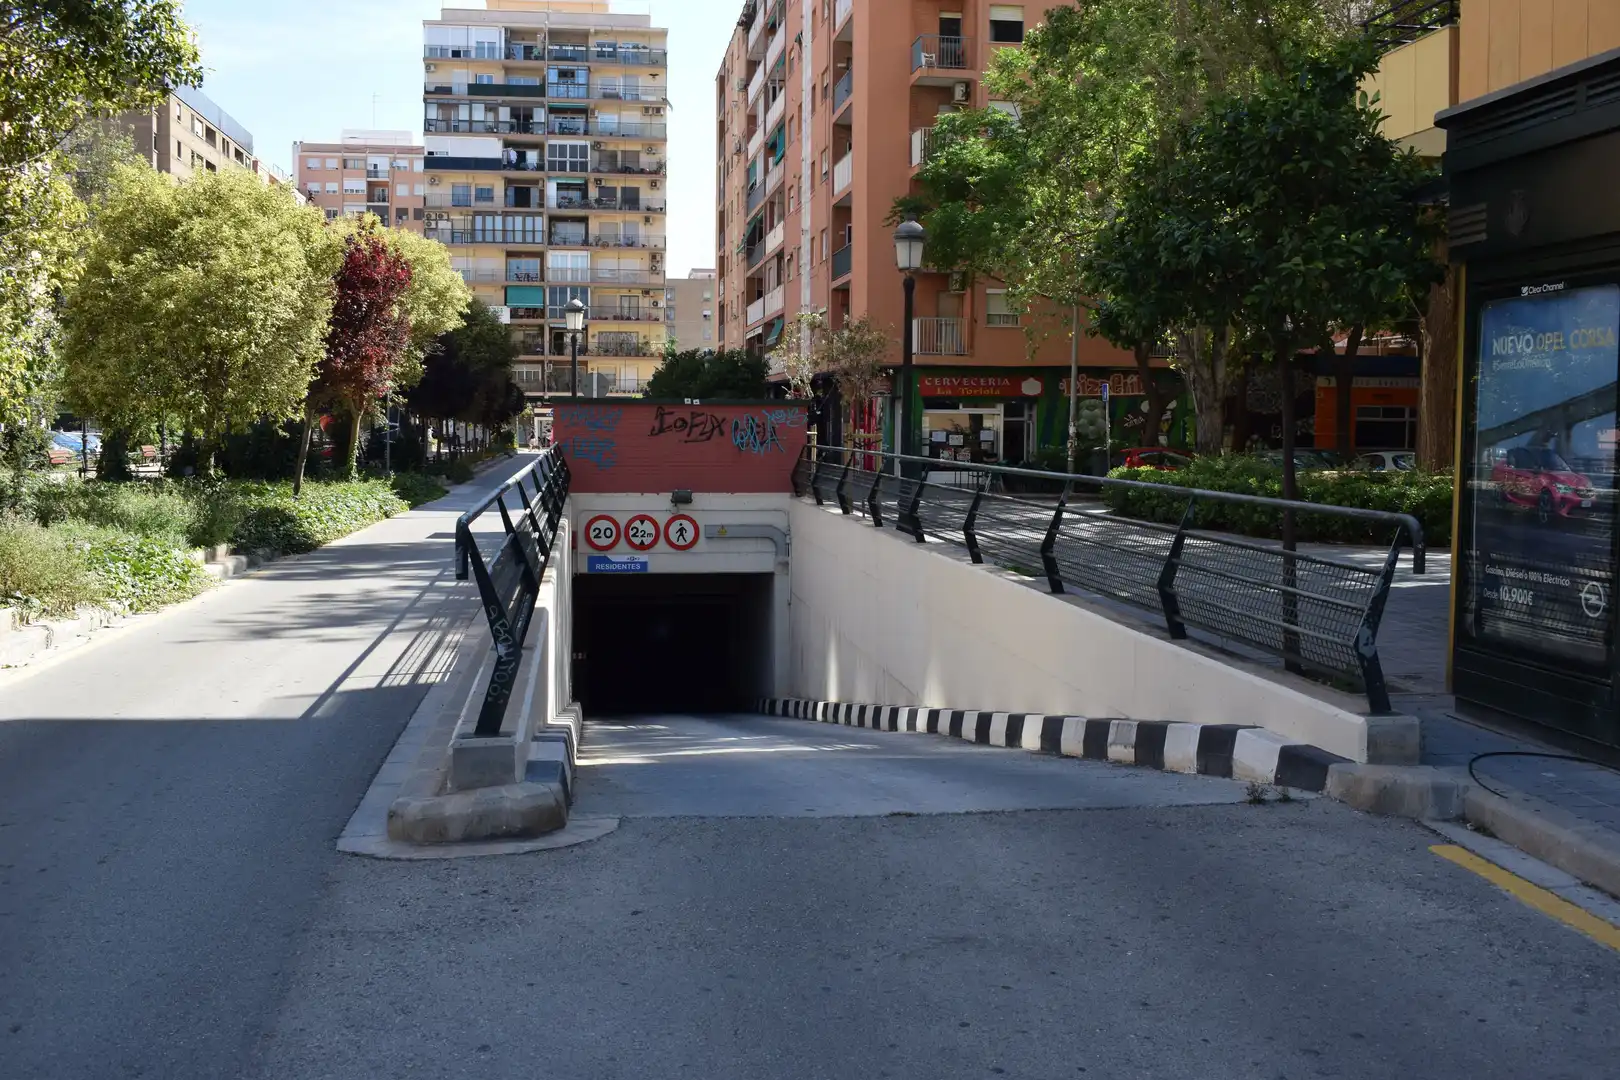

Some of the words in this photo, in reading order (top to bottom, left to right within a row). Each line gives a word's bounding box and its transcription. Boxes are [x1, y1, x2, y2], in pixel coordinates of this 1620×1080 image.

[1529, 285, 1541, 294] Clear
[1542, 281, 1564, 292] Channel
[1492, 334, 1534, 355] NUEVO
[1536, 331, 1566, 351] OPEL
[1570, 327, 1616, 349] CORSA
[593, 527, 613, 538] 20
[1543, 573, 1571, 587] Eléctrico
[1499, 585, 1534, 606] 10.900€
